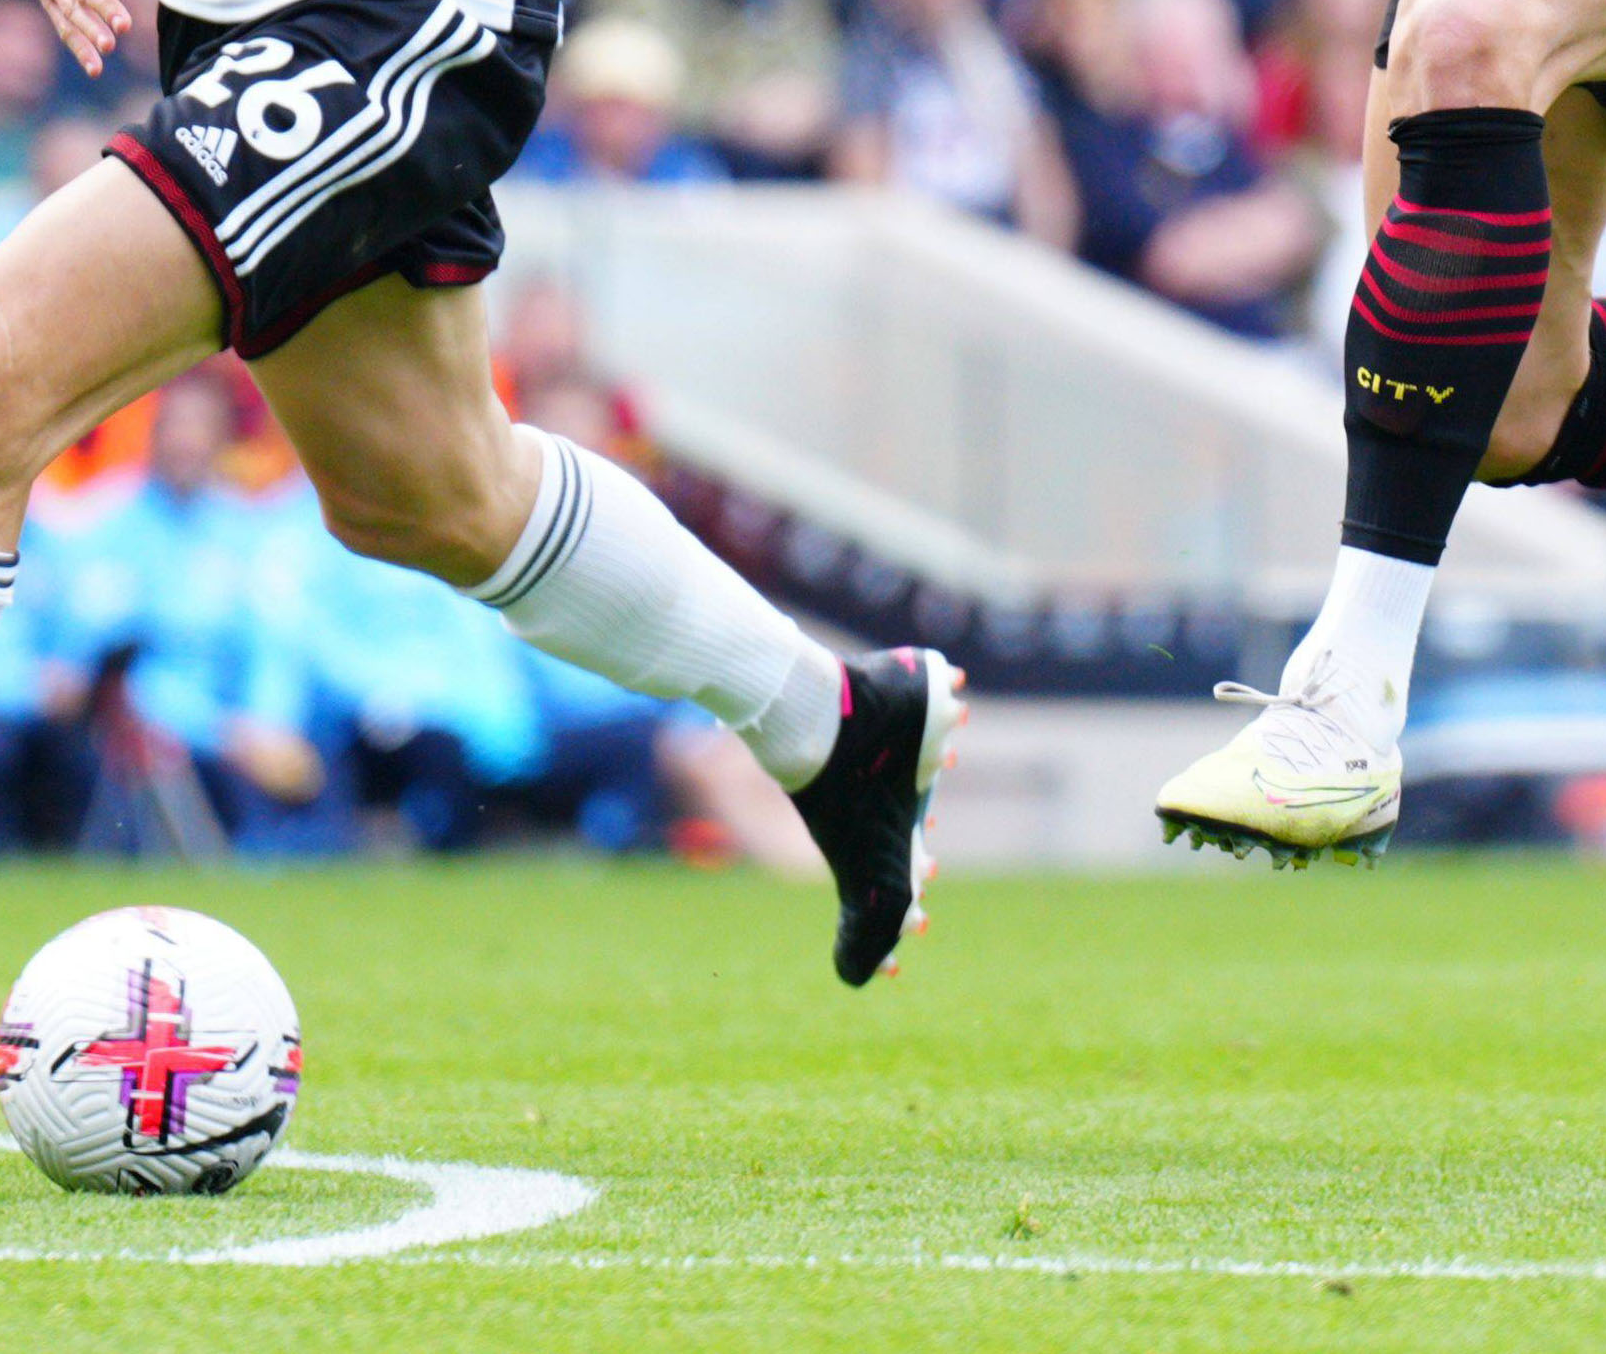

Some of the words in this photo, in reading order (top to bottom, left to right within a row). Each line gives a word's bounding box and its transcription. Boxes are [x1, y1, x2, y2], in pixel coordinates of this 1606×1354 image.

[175, 37, 357, 161] 26
[175, 126, 229, 187] adidas
[1357, 366, 1455, 404] CITY
